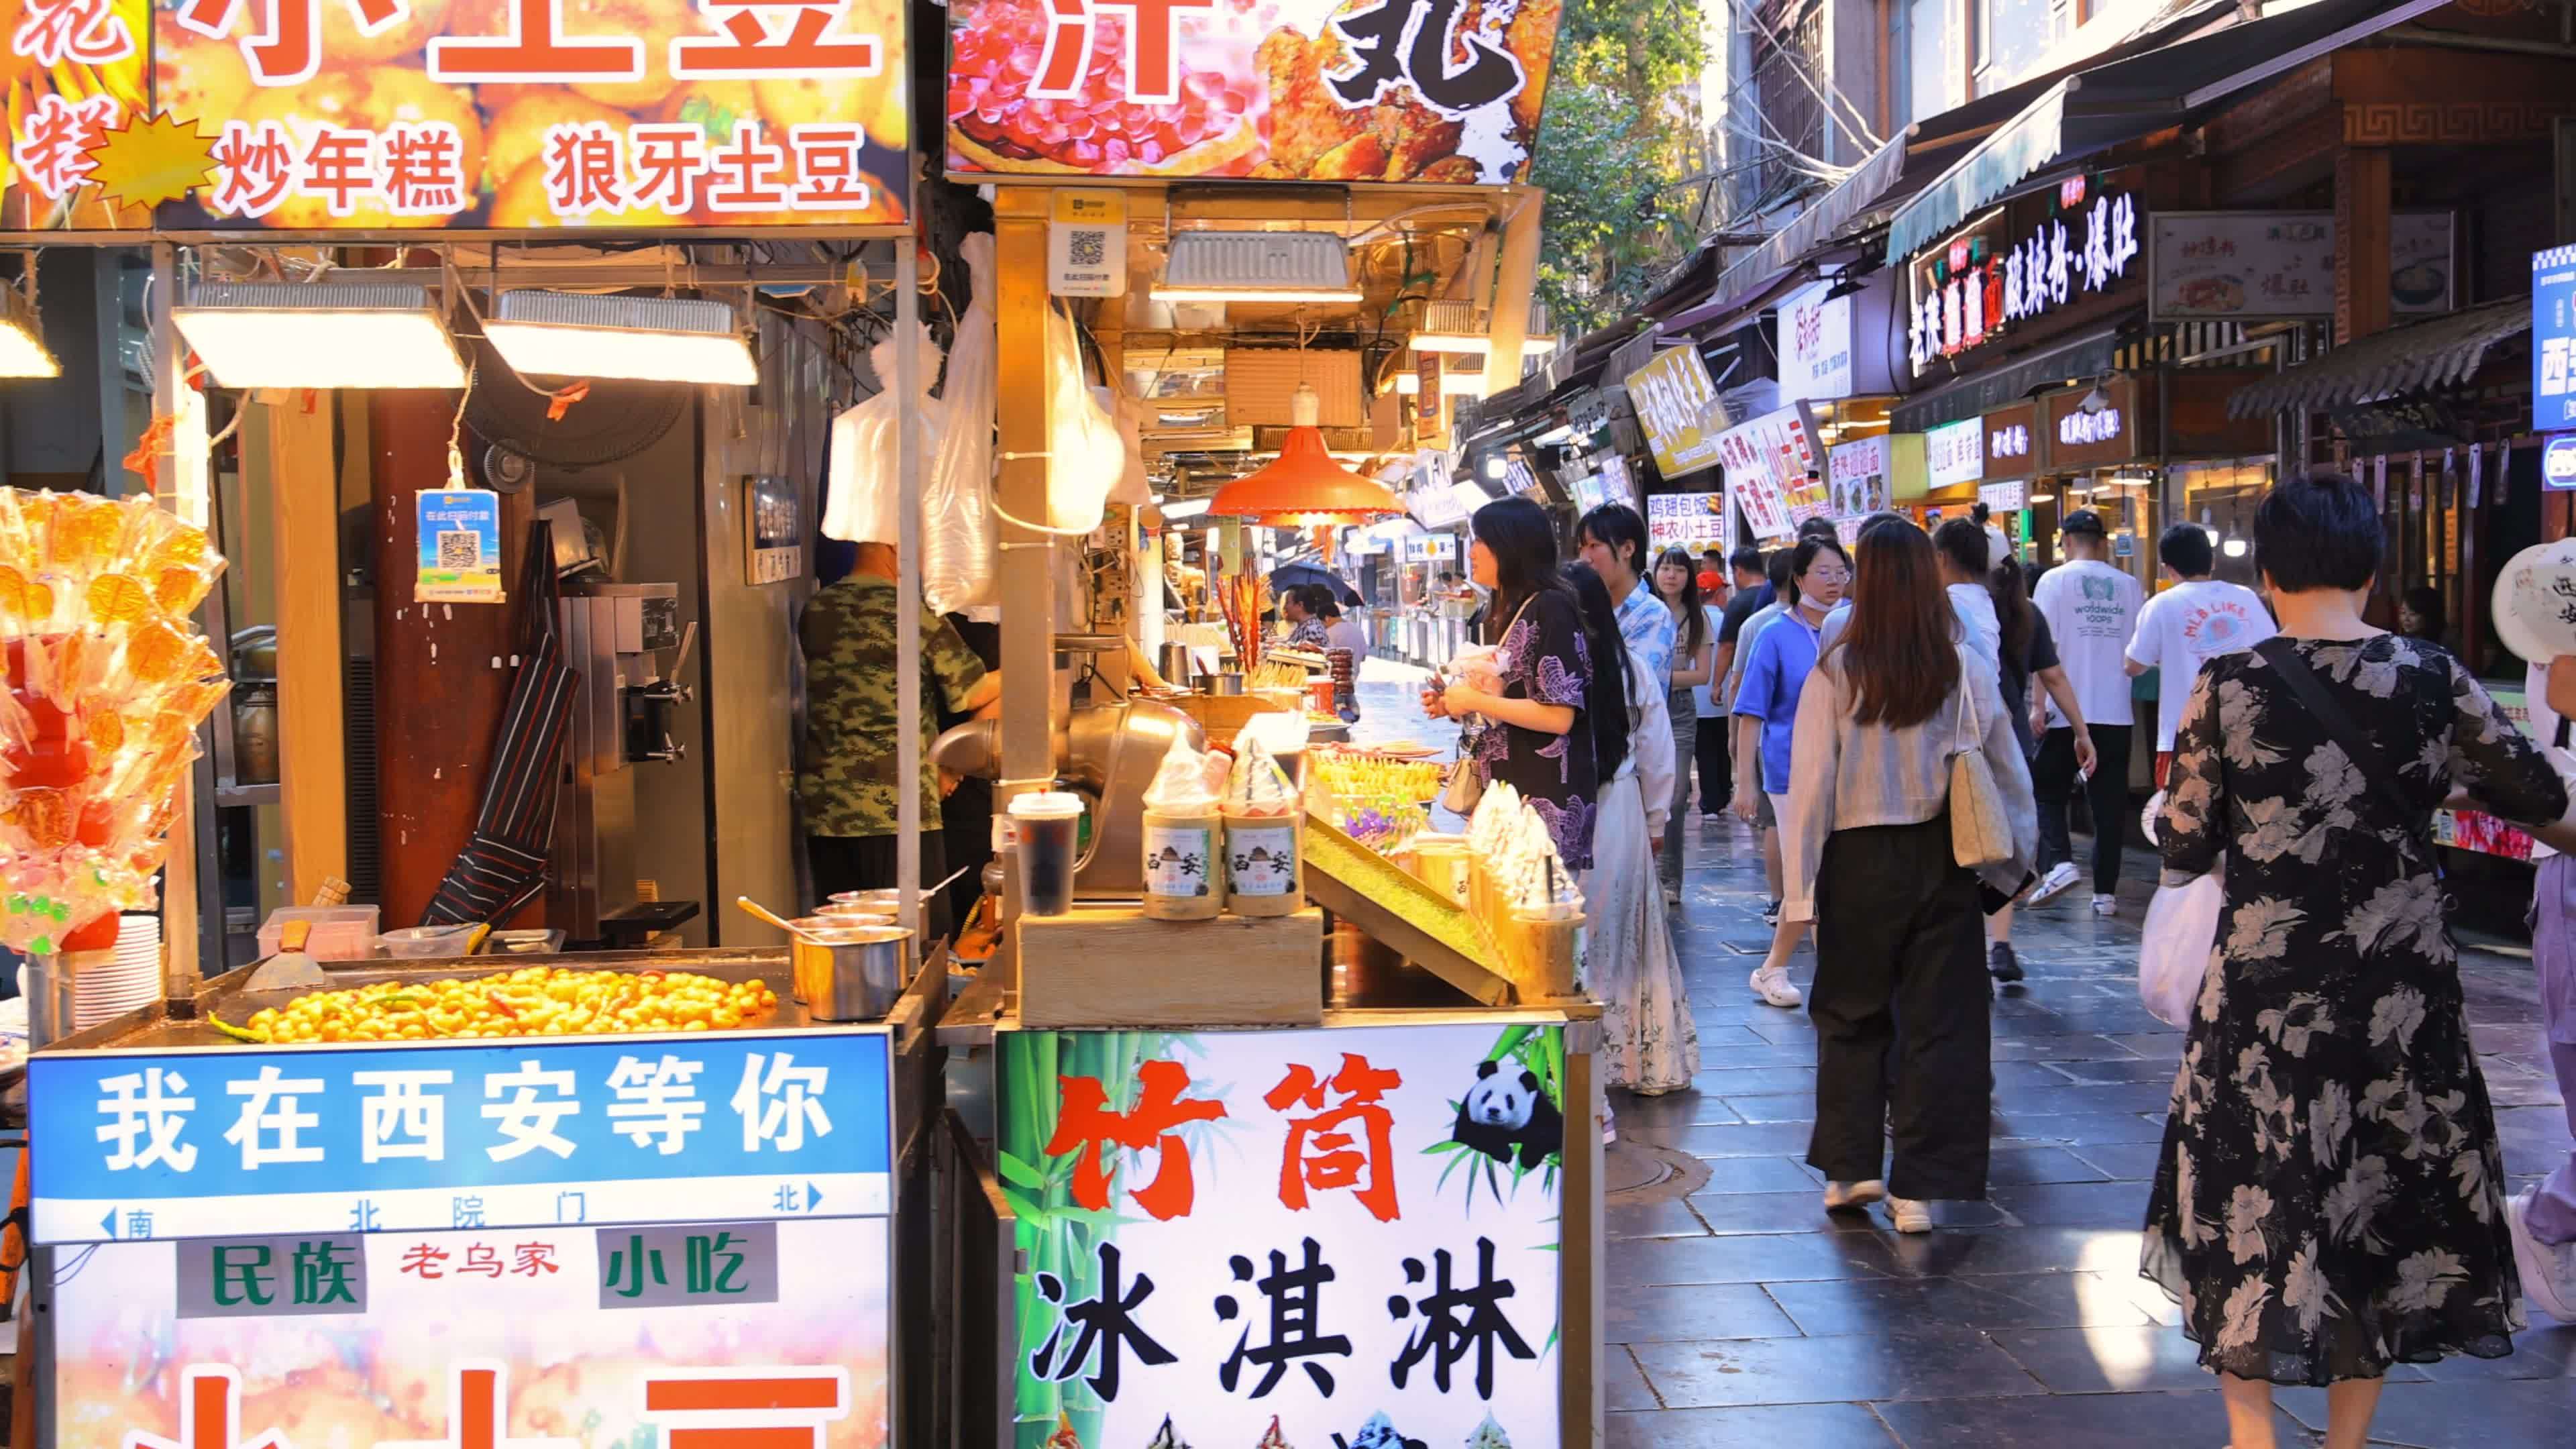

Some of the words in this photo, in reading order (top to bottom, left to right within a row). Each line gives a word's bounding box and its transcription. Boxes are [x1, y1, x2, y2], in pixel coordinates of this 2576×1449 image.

[216, 126, 459, 211] 炒年糕
[549, 126, 864, 209] 狼牙土豆
[1650, 496, 1709, 518] 鸡翅包饭
[1652, 519, 1723, 541] 神农小土豆
[96, 1051, 833, 1173] 我在西安等你
[1044, 1051, 1403, 1223] 竹筒
[126, 1208, 154, 1239] 南
[773, 1184, 800, 1212] 北
[212, 1240, 358, 1306] 民族
[604, 1231, 750, 1298] 小吃
[1030, 1234, 1538, 1403] 冰淇淋
